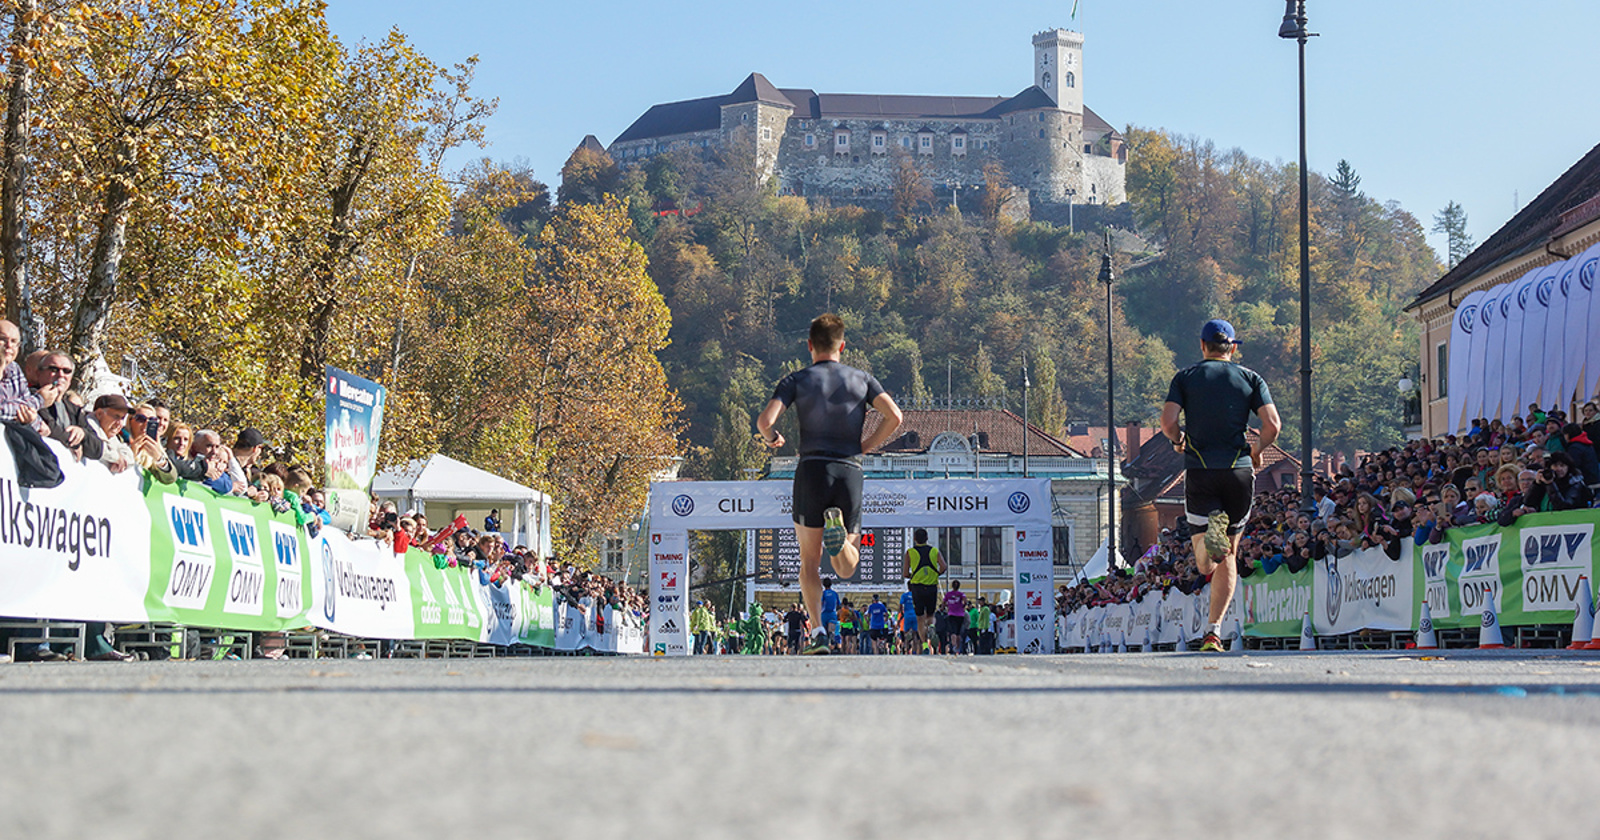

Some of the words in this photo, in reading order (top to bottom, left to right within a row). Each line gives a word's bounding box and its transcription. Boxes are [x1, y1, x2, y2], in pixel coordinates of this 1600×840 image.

[718, 498, 754, 513] CILJ
[926, 496, 988, 511] FINISH
[861, 534, 875, 547] 43
[1019, 550, 1048, 558] TIMING
[655, 553, 683, 561] TIMING
[171, 559, 212, 598] OMV
[231, 569, 262, 605] OMV
[335, 559, 397, 611] Volkswagen
[1344, 571, 1396, 608] Volkswagen
[1526, 574, 1583, 603] OMV
[278, 577, 300, 610] OMV
[1255, 580, 1312, 623] Mercator
[1426, 585, 1446, 612] OMV
[658, 604, 680, 612] OMV
[1023, 623, 1046, 631] OMV
